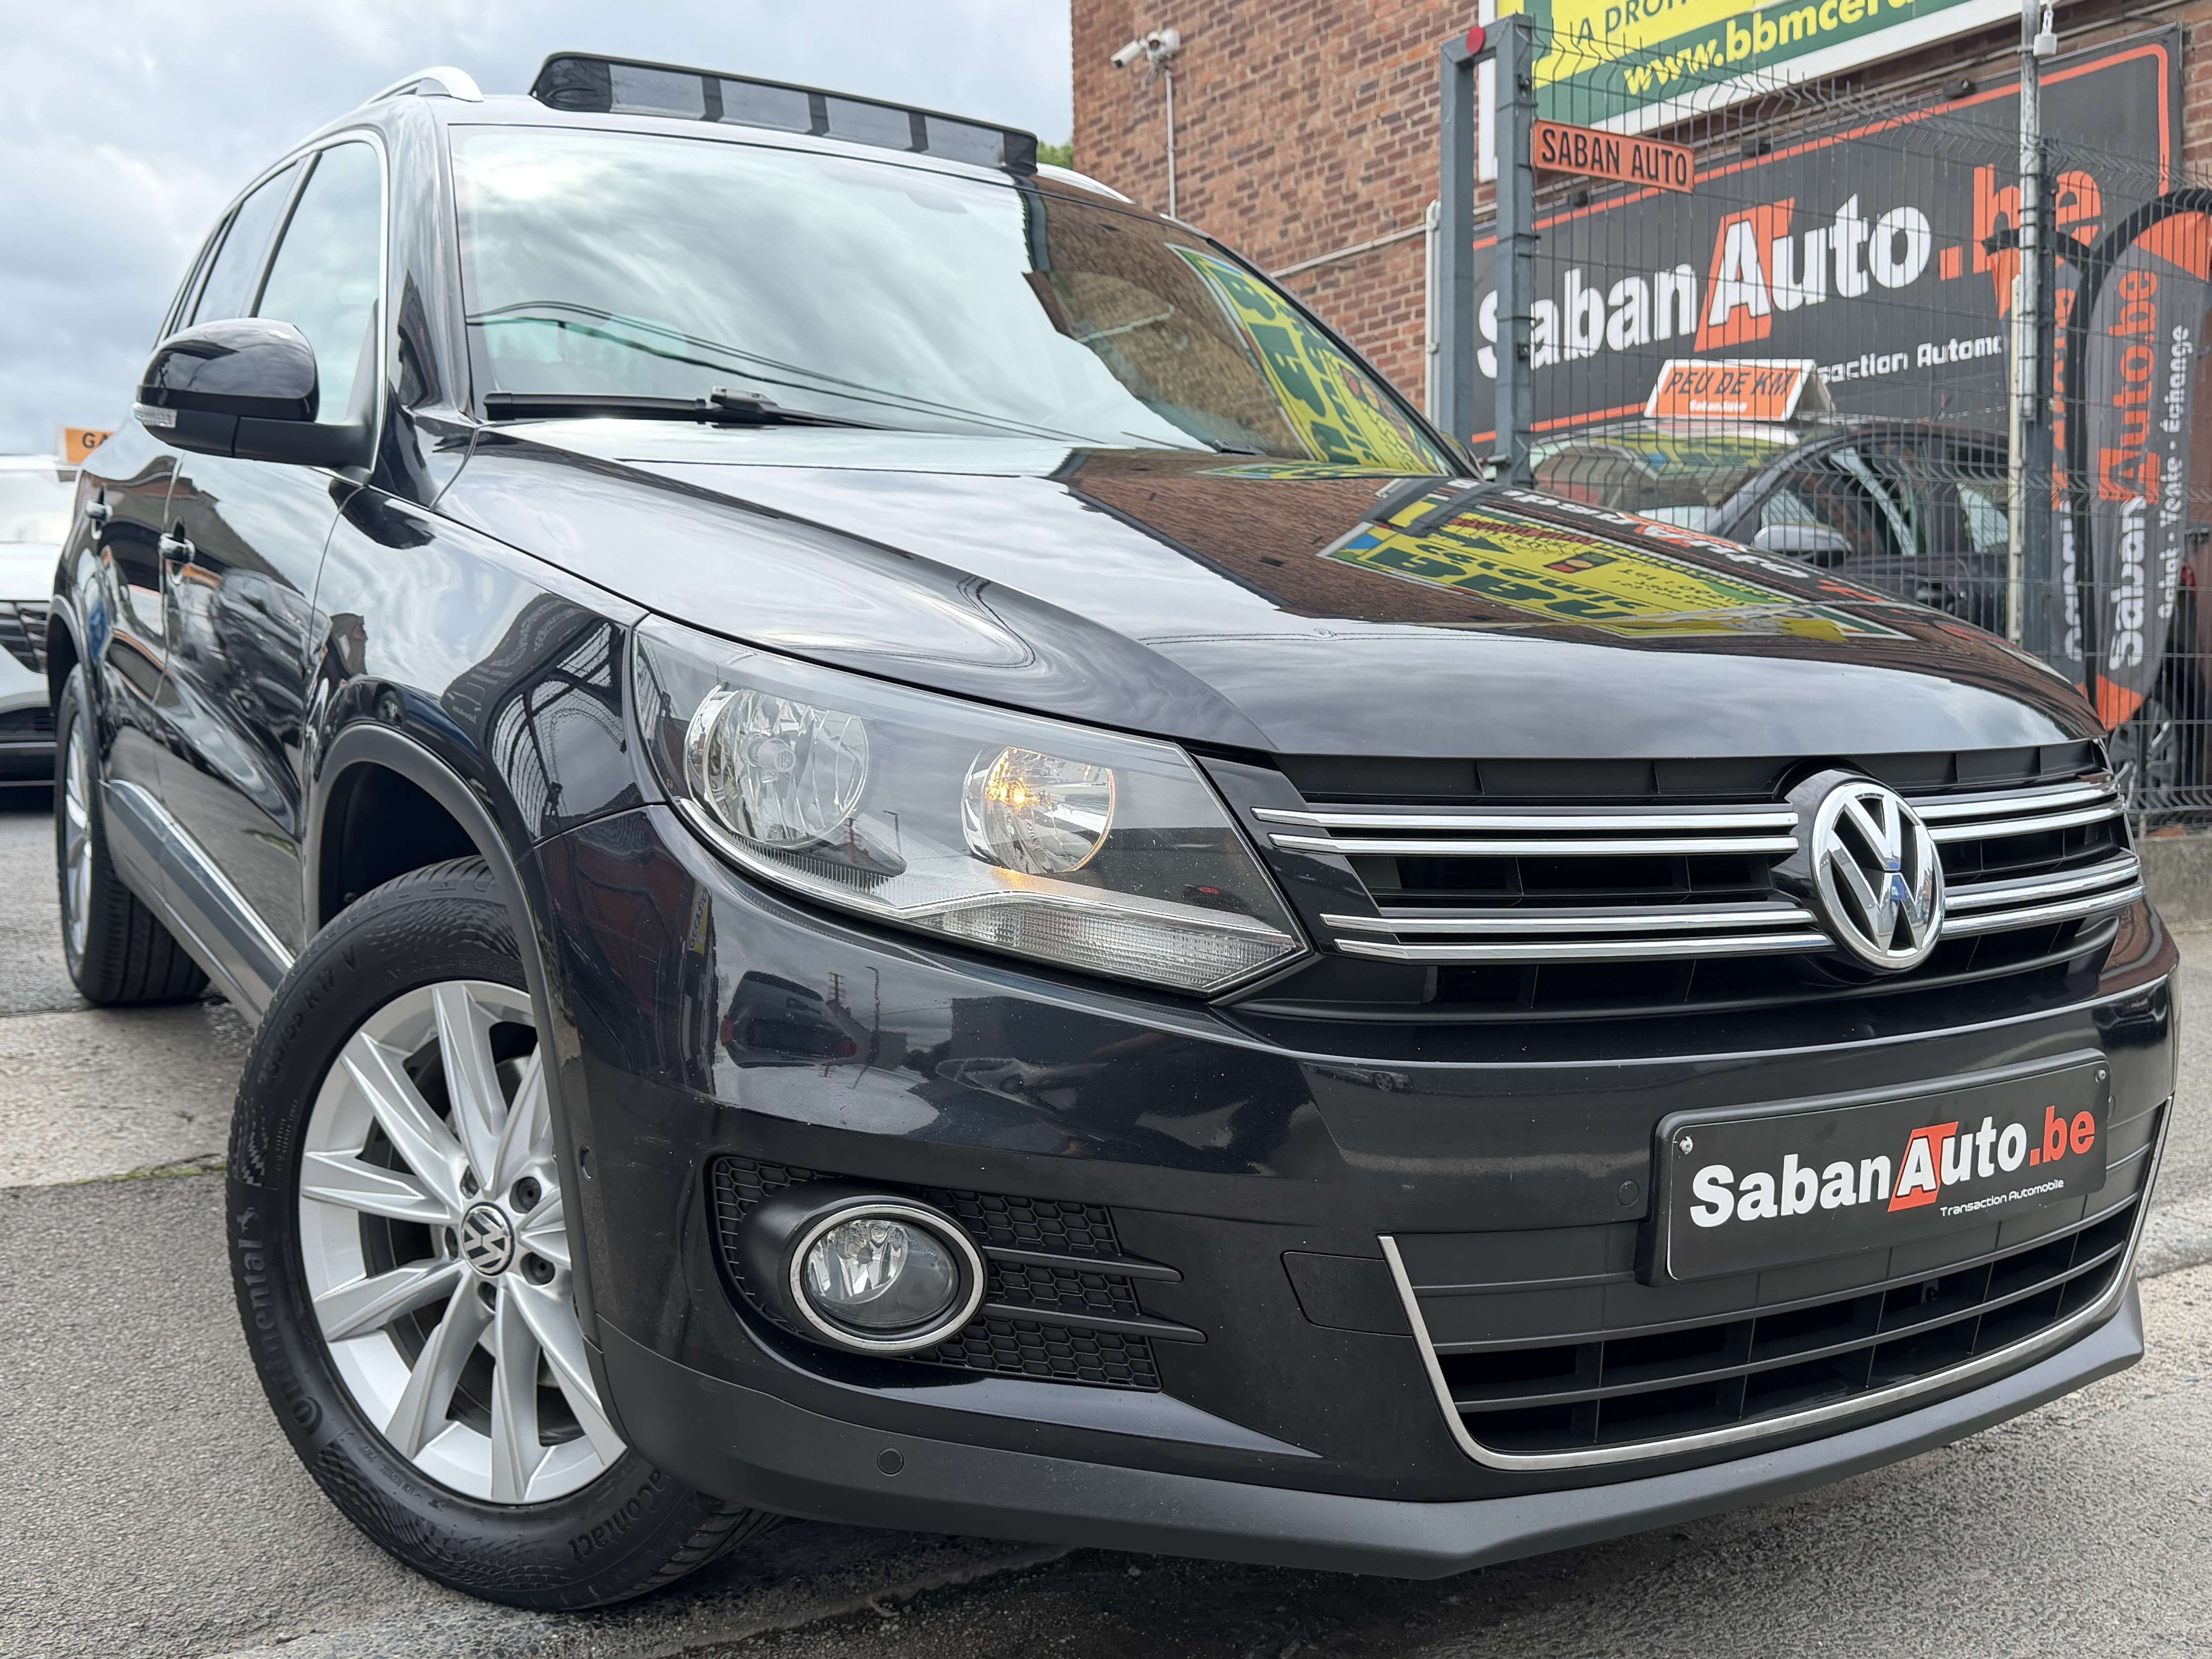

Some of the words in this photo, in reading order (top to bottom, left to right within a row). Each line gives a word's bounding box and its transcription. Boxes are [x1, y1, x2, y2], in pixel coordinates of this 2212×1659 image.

[1577, 17, 1594, 45] A
[1606, 0, 1686, 34] DRO
[1624, 0, 1915, 95] www.bbmce
[1542, 129, 1620, 174] SABAN
[1631, 144, 1688, 186] AUTO
[1665, 371, 1714, 395] PEU
[1714, 371, 1751, 395] DE
[1750, 371, 1797, 396] KM
[2098, 270, 2160, 670] SabanAuto.be
[1690, 1106, 2095, 1228] SabanAuto.be
[1940, 1194, 2007, 1217] Transaction
[2008, 1179, 2064, 1201] Automobile
